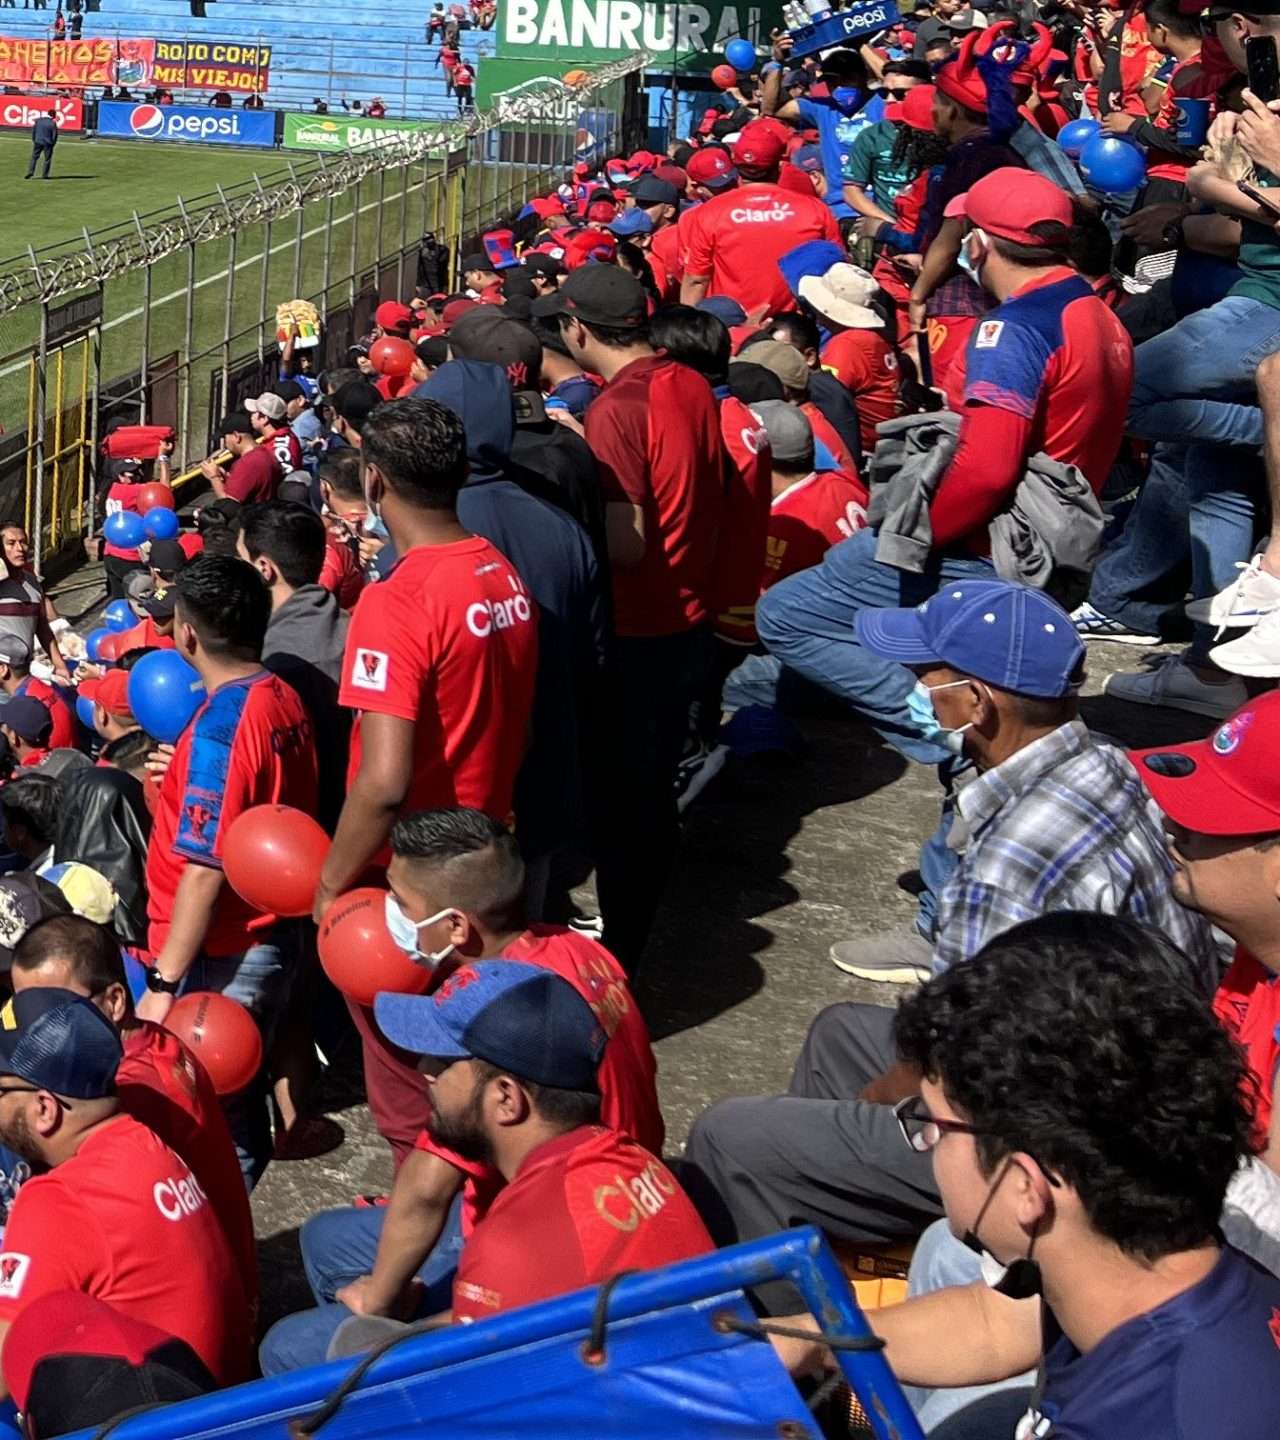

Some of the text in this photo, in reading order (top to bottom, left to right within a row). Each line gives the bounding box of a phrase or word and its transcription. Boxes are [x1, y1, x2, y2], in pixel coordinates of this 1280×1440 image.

[843, 6, 887, 33] pepsi
[156, 42, 270, 67] ROJO COMO
[153, 64, 264, 91] MIS VIEJOS
[168, 114, 241, 138] pepsi
[730, 205, 787, 224] Claro
[466, 592, 532, 638] Claro
